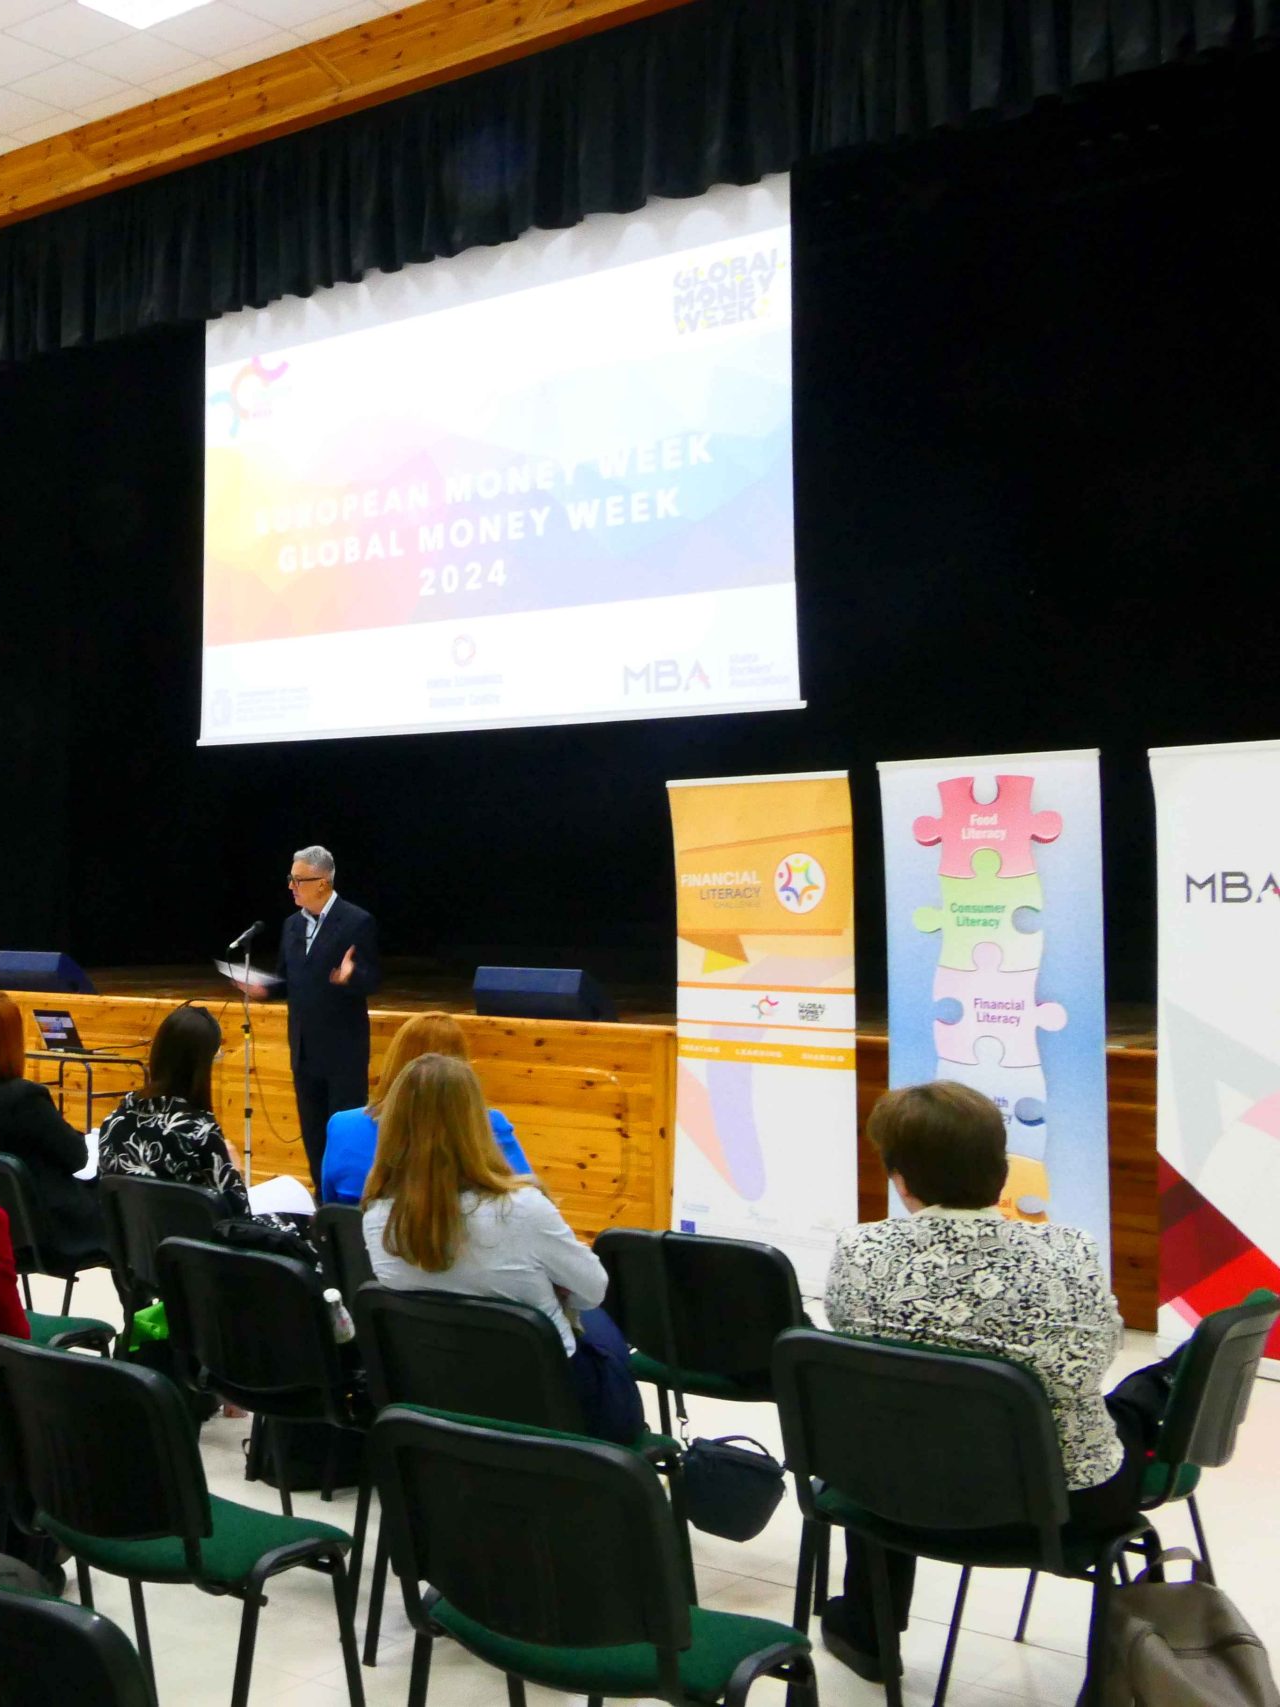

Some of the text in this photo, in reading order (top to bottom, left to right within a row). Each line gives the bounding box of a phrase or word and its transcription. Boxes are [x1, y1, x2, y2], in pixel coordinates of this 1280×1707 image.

[673, 271, 775, 314] MONEY
[673, 297, 757, 334] WEEK
[445, 456, 576, 505] MONEY
[597, 431, 714, 476] WEEK
[278, 486, 682, 573] GLOBAL MONEY WEEK
[418, 560, 508, 596] 2024
[623, 659, 711, 695] MBA
[969, 813, 998, 826] Food
[961, 828, 1007, 841] Literacy
[680, 870, 761, 887] FINANCIAL
[700, 886, 761, 900] LITERACY
[950, 902, 1007, 914] Consumer
[956, 916, 1001, 929] Literacy
[973, 997, 1025, 1011] Financial
[976, 1012, 1021, 1026] Literacy
